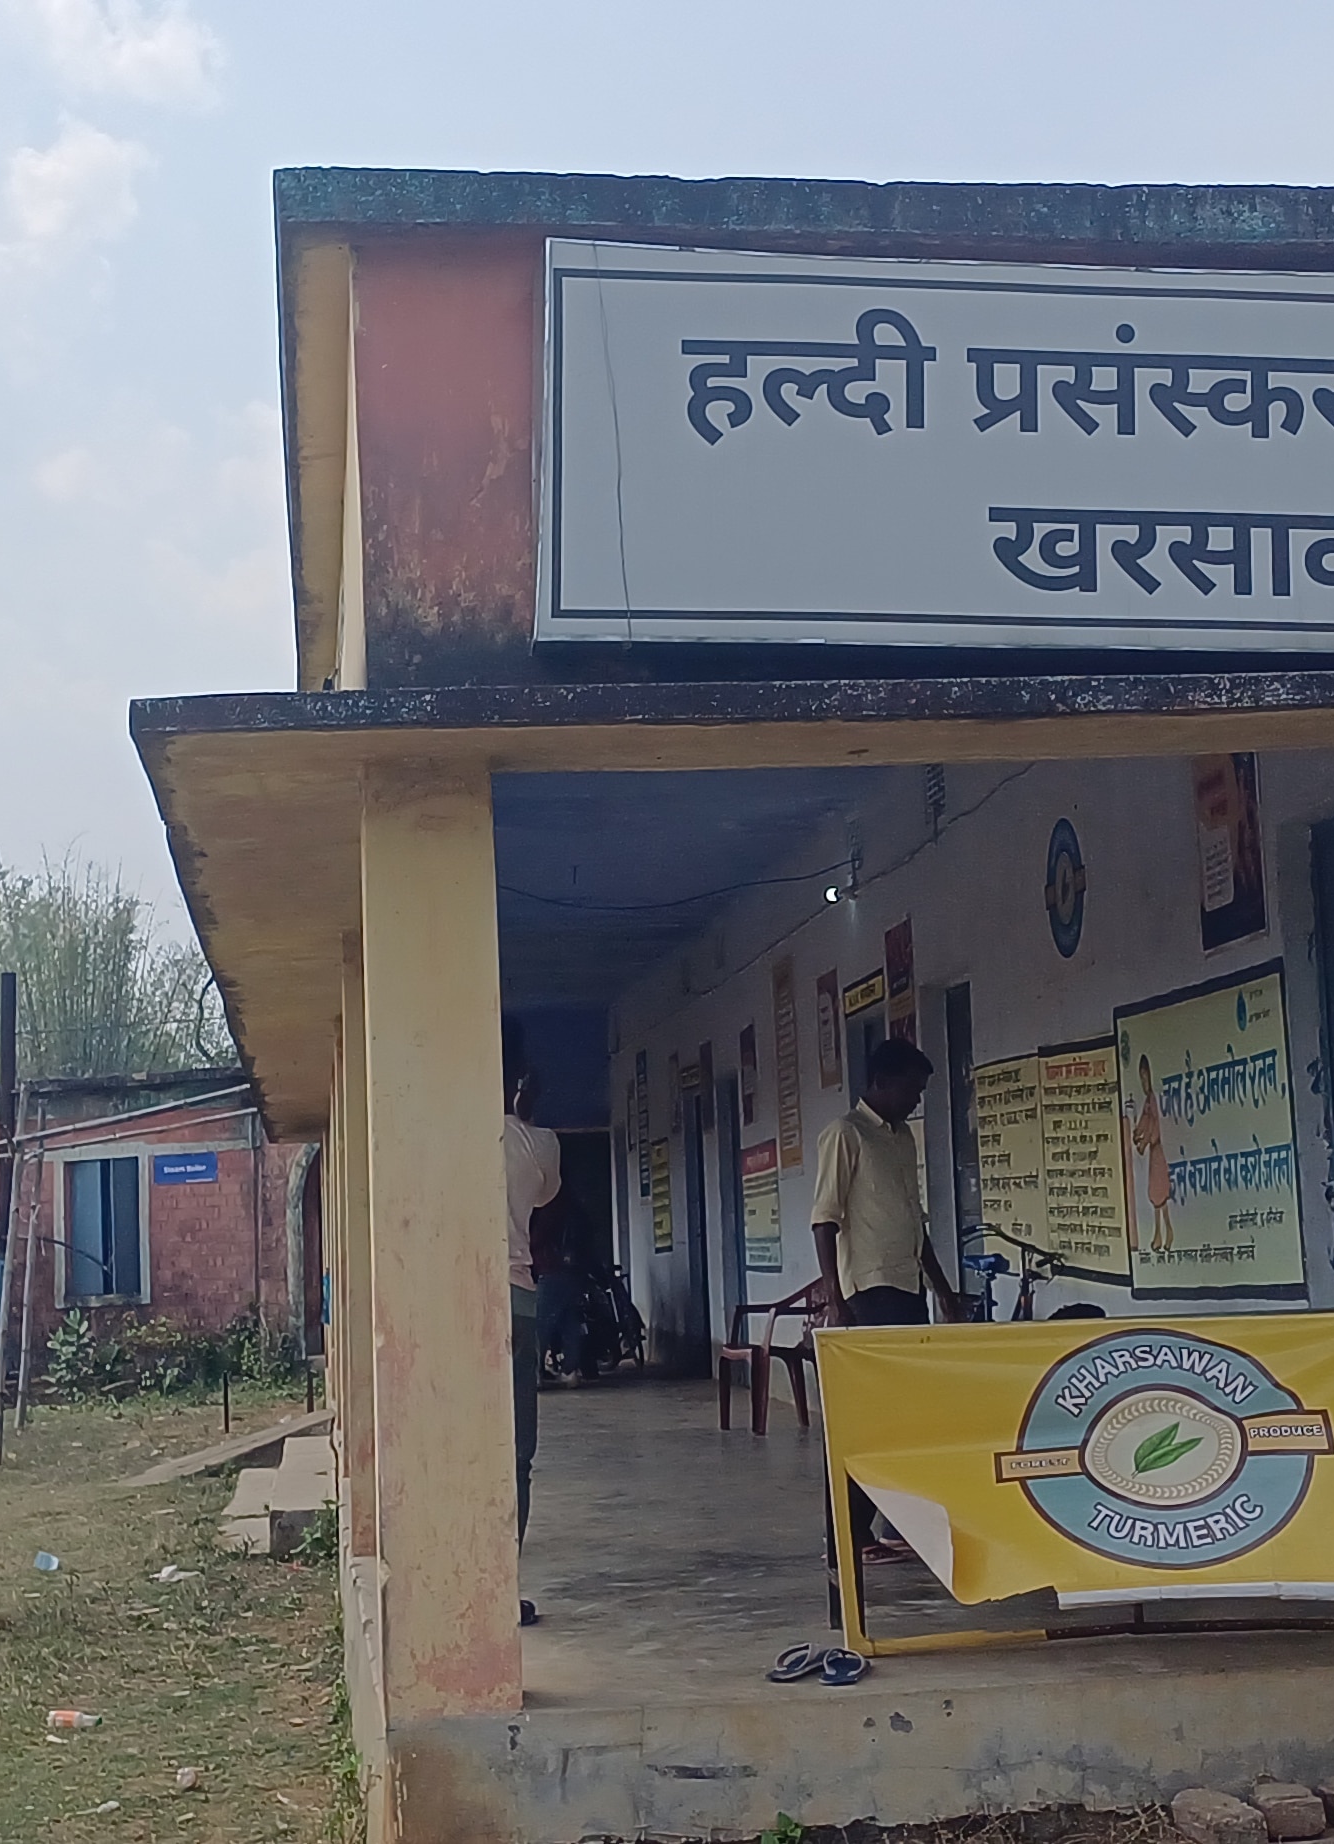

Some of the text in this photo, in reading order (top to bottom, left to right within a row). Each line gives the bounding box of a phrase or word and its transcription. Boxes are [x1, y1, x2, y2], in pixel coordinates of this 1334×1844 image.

[681, 308, 937, 446] हल्दी
[1159, 1073, 1183, 1125] जल
[1184, 1048, 1195, 1127] है
[1196, 1043, 1248, 1116] अनमोल
[1055, 1345, 1259, 1417] KHARSAWAN
[1249, 1425, 1324, 1438] PRODUCE
[1088, 1492, 1263, 1549] TURMERIC
